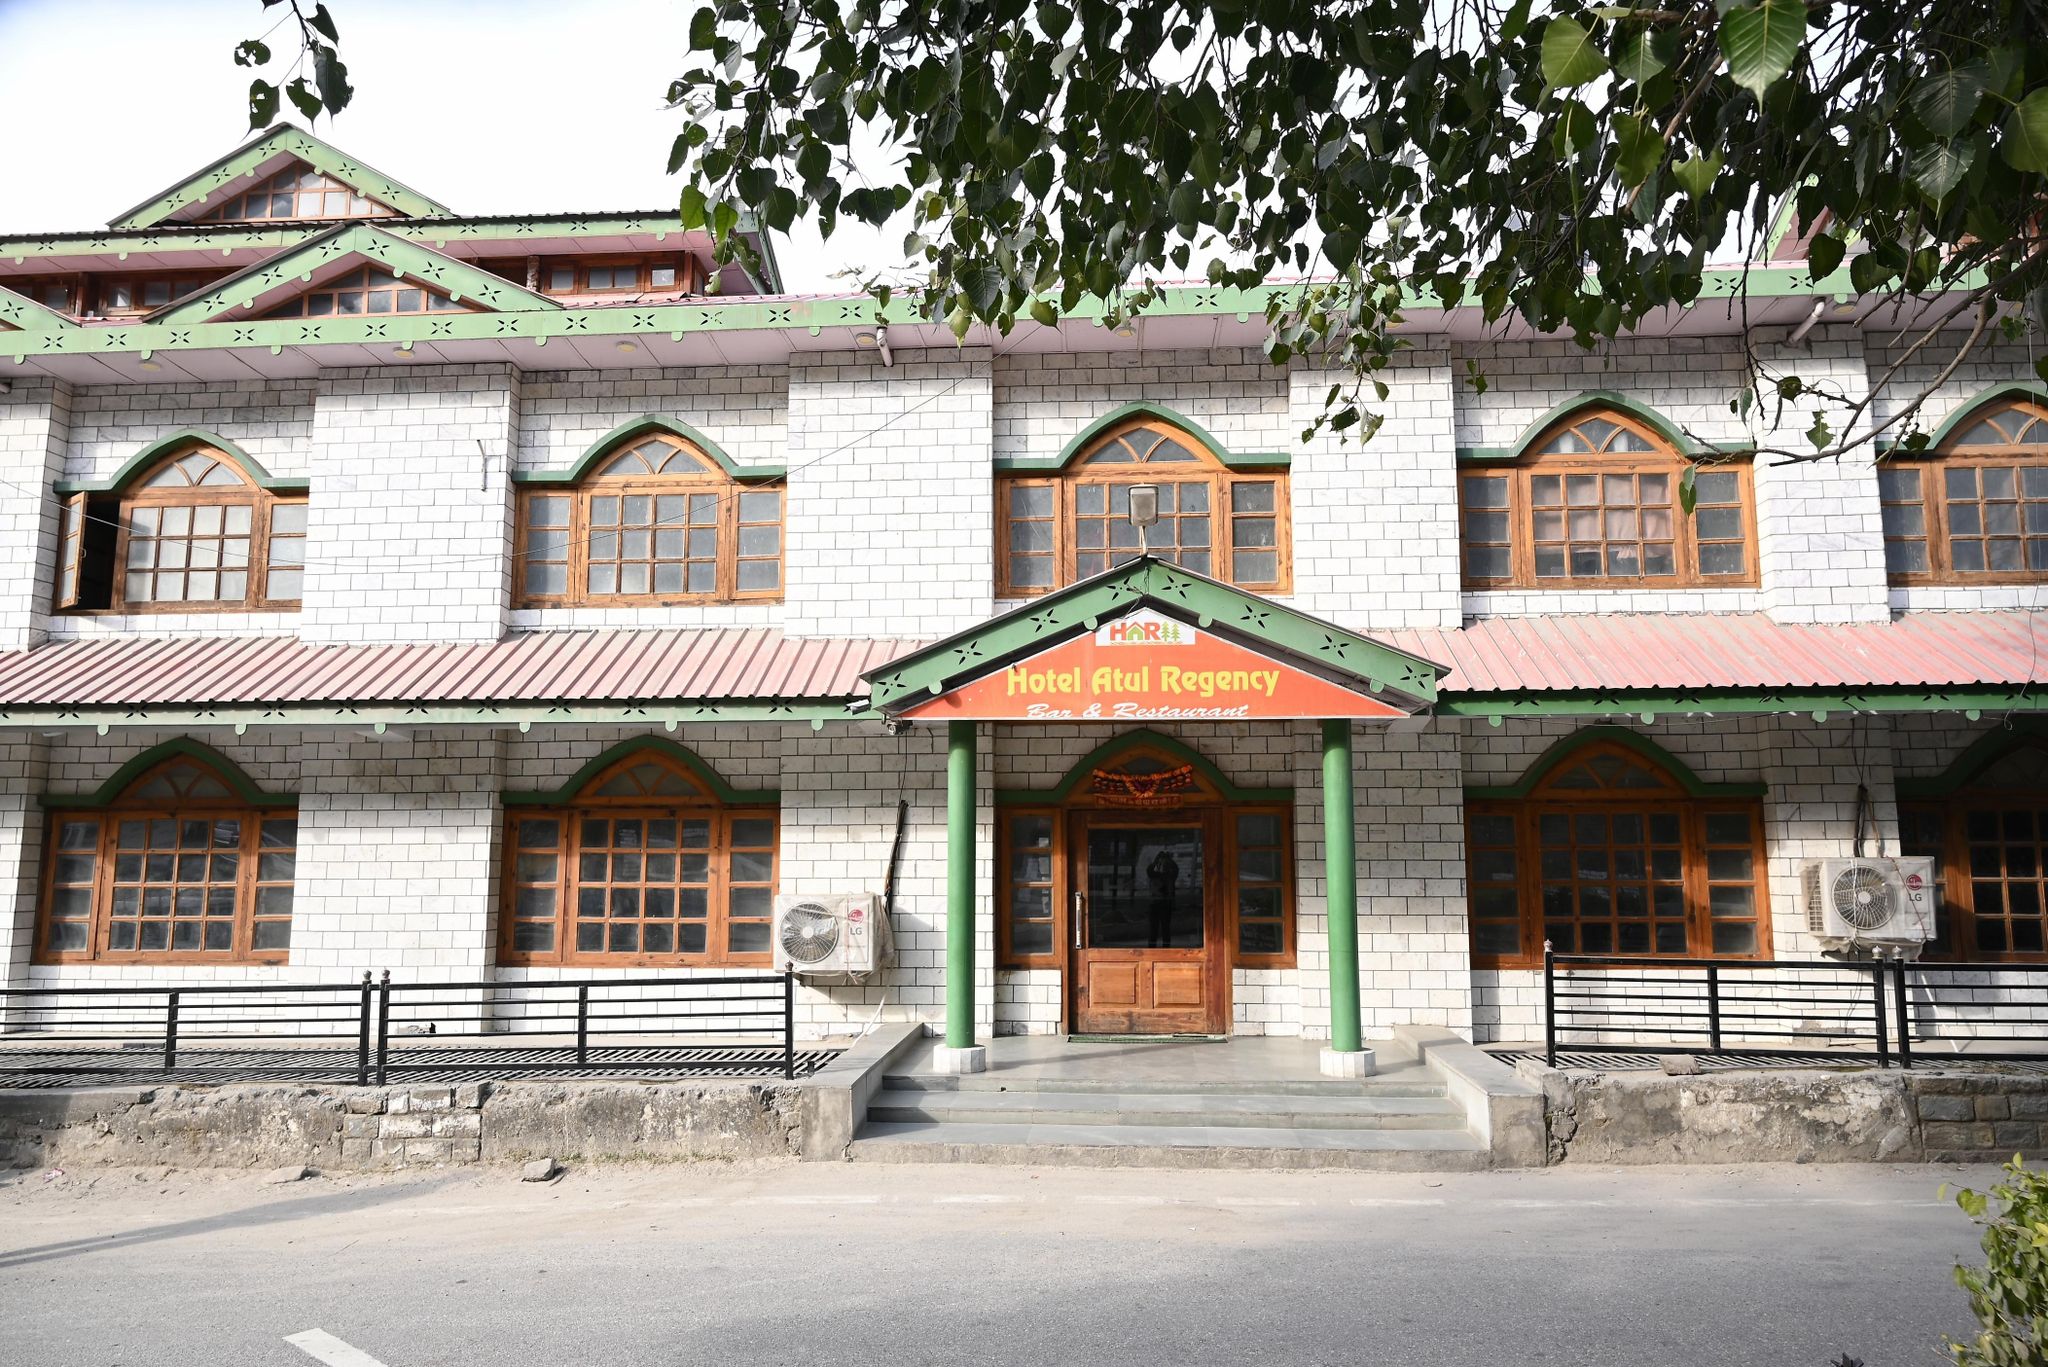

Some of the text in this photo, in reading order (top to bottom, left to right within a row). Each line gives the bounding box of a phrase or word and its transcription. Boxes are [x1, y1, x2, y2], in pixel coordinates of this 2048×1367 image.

[1007, 665, 1280, 698] Hotel Atul Regency
[1026, 703, 1249, 718] Bar & Restaurant
[1909, 893, 1922, 901] LG
[850, 927, 862, 935] LG
